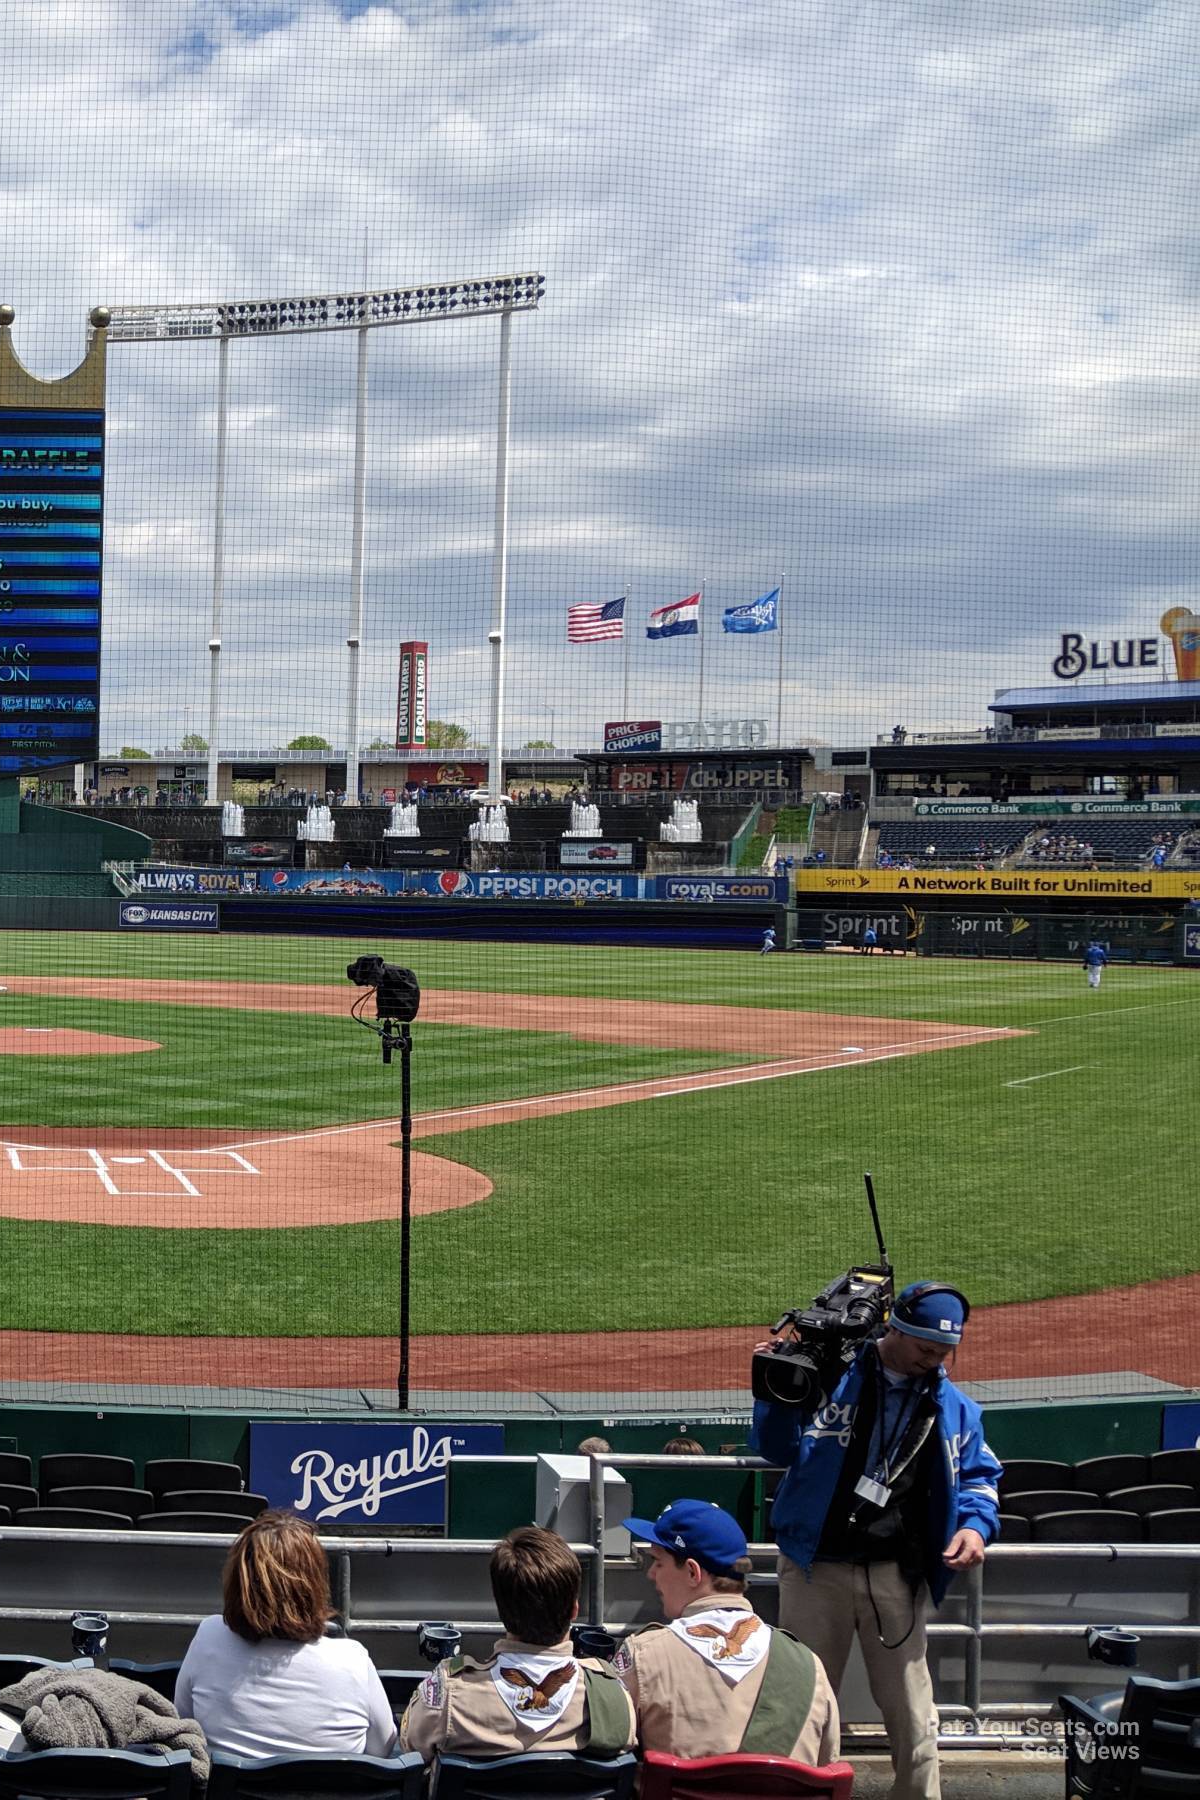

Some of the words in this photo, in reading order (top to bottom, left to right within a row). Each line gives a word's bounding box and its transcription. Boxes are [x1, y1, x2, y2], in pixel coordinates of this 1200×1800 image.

[2, 450, 88, 469] RAFFLE
[21, 498, 53, 511] buy,
[13, 643, 30, 661] &
[1054, 633, 1158, 679] BLUE
[399, 660, 409, 736] BOULEVARD
[416, 660, 425, 736] BOULEVARD
[608, 722, 642, 738] PRICE
[667, 720, 769, 748] PATIO
[605, 731, 660, 752] CHOPPER
[931, 804, 989, 814] Commerce
[991, 803, 1020, 813] Bank
[1088, 803, 1150, 813] Commerce
[1151, 802, 1182, 812] Bank
[138, 873, 195, 888] ALWAYS
[199, 874, 240, 889] ROYAL
[479, 877, 537, 897] PEPSI
[545, 878, 622, 897] PORCH
[670, 880, 769, 897] royals.com
[826, 875, 856, 888] Sprint
[898, 877, 910, 889] A
[914, 877, 988, 890] Network
[991, 877, 1031, 891] Built
[1034, 878, 1060, 891] for
[1063, 879, 1153, 893] Unlimited
[128, 909, 144, 917] FOX
[150, 910, 192, 921] KANSAS
[192, 910, 216, 921] CITY
[824, 913, 900, 939] Sprint
[290, 1426, 452, 1520] Royals
